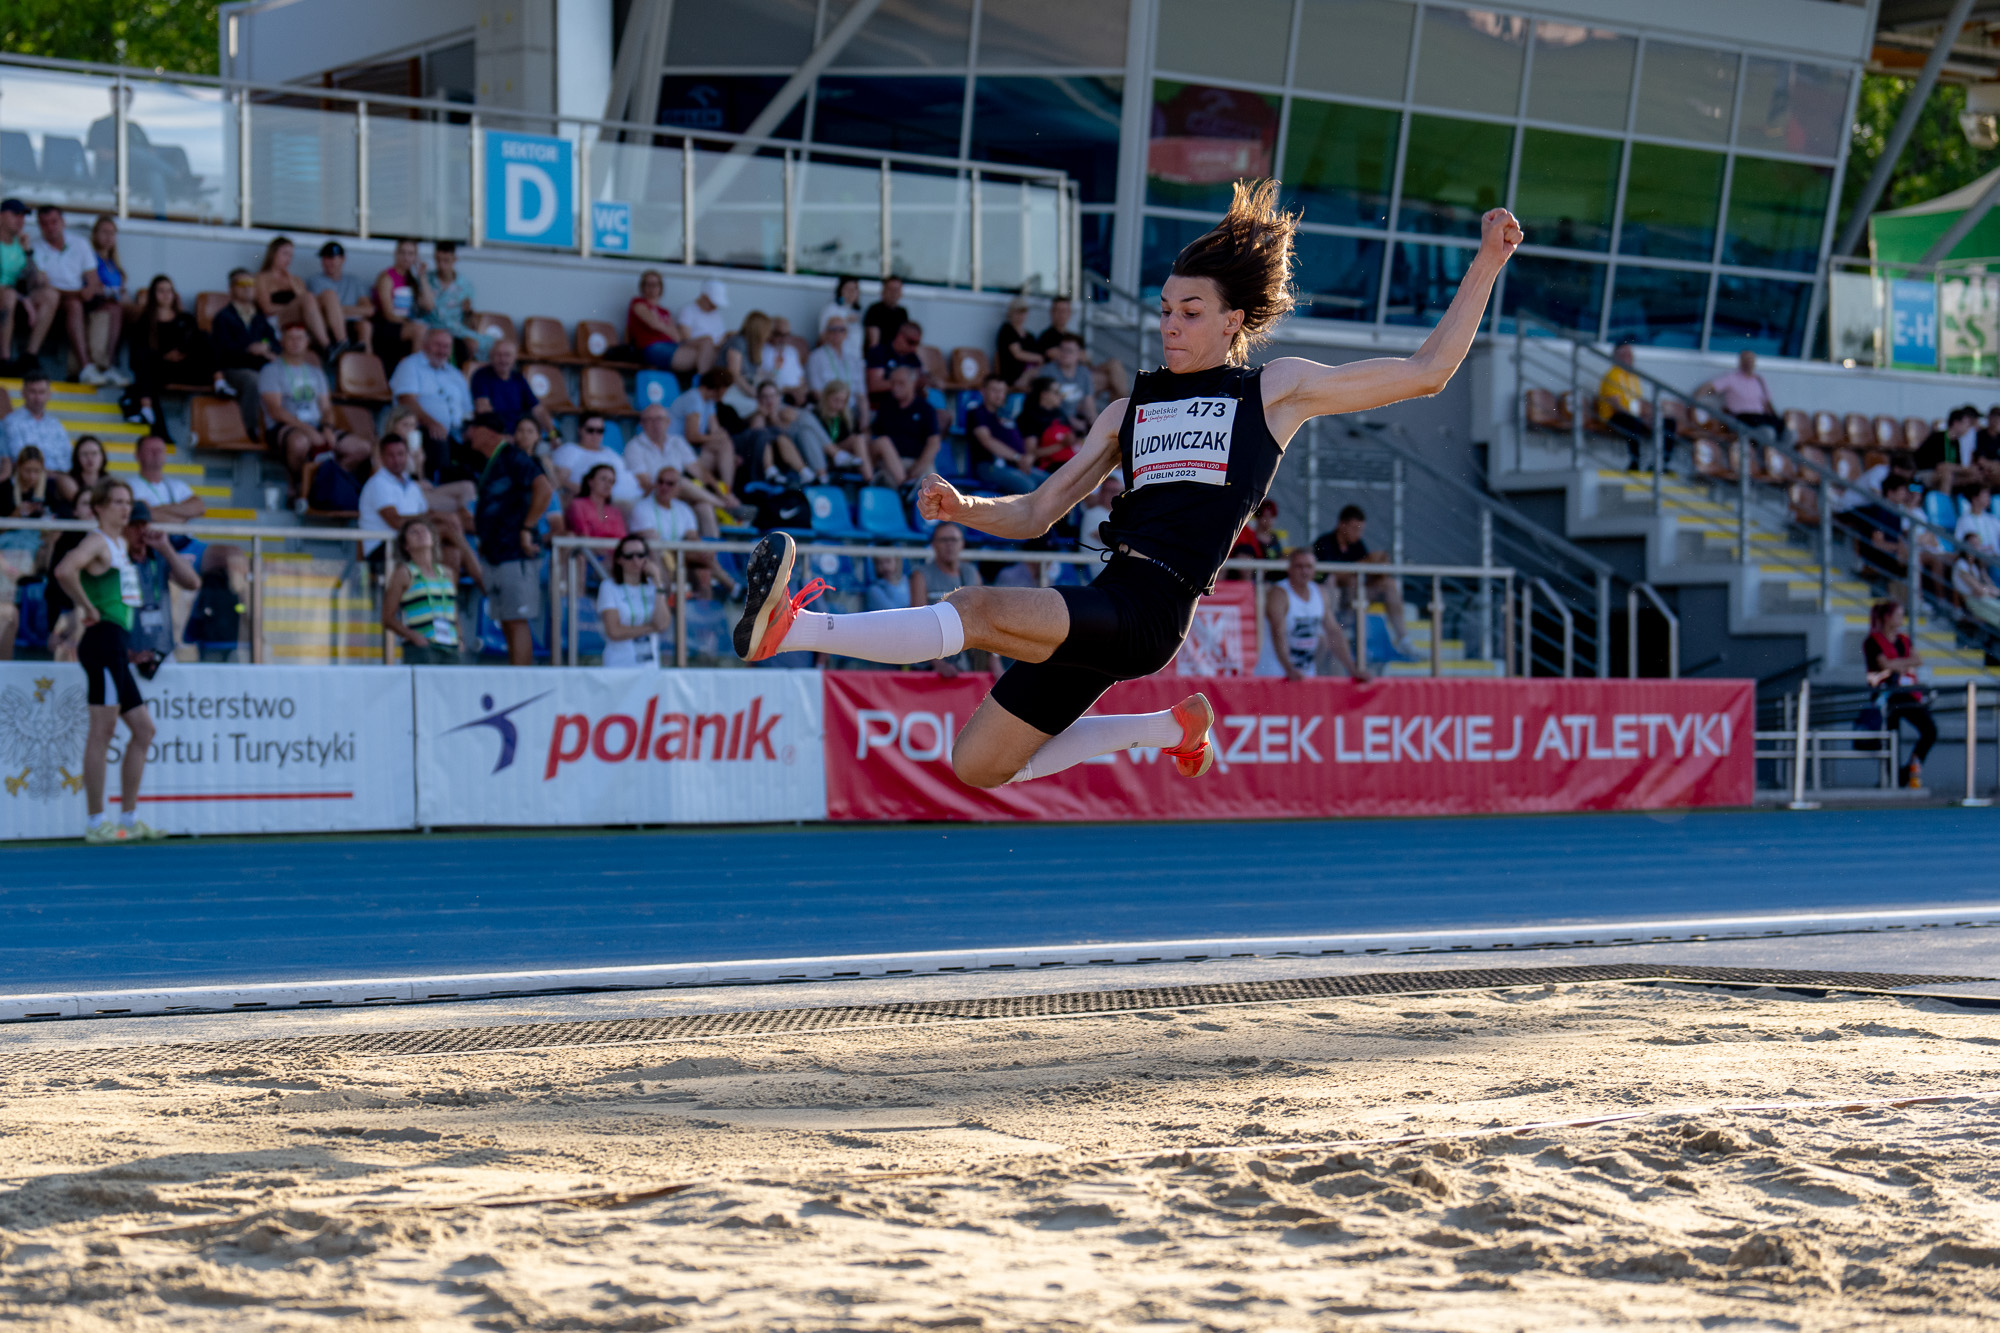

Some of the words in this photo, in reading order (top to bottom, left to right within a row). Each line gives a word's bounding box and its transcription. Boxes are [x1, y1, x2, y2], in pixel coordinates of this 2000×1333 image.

[502, 140, 558, 162] SEKTOR
[505, 162, 558, 236] D
[594, 208, 628, 232] WC
[1186, 401, 1227, 418] 473
[1134, 431, 1227, 459] LUDWICZAK
[1146, 471, 1174, 480] LUBLIN
[1152, 461, 1187, 471] Mistrzostwa
[143, 689, 296, 720] nisterstwo
[105, 730, 203, 764] Sortu
[212, 733, 218, 763] i
[227, 730, 355, 768] Turystyki
[543, 693, 784, 781] polanik
[1334, 714, 1523, 763] LEKKIEJ
[1532, 713, 1732, 761] ATLETYKI
